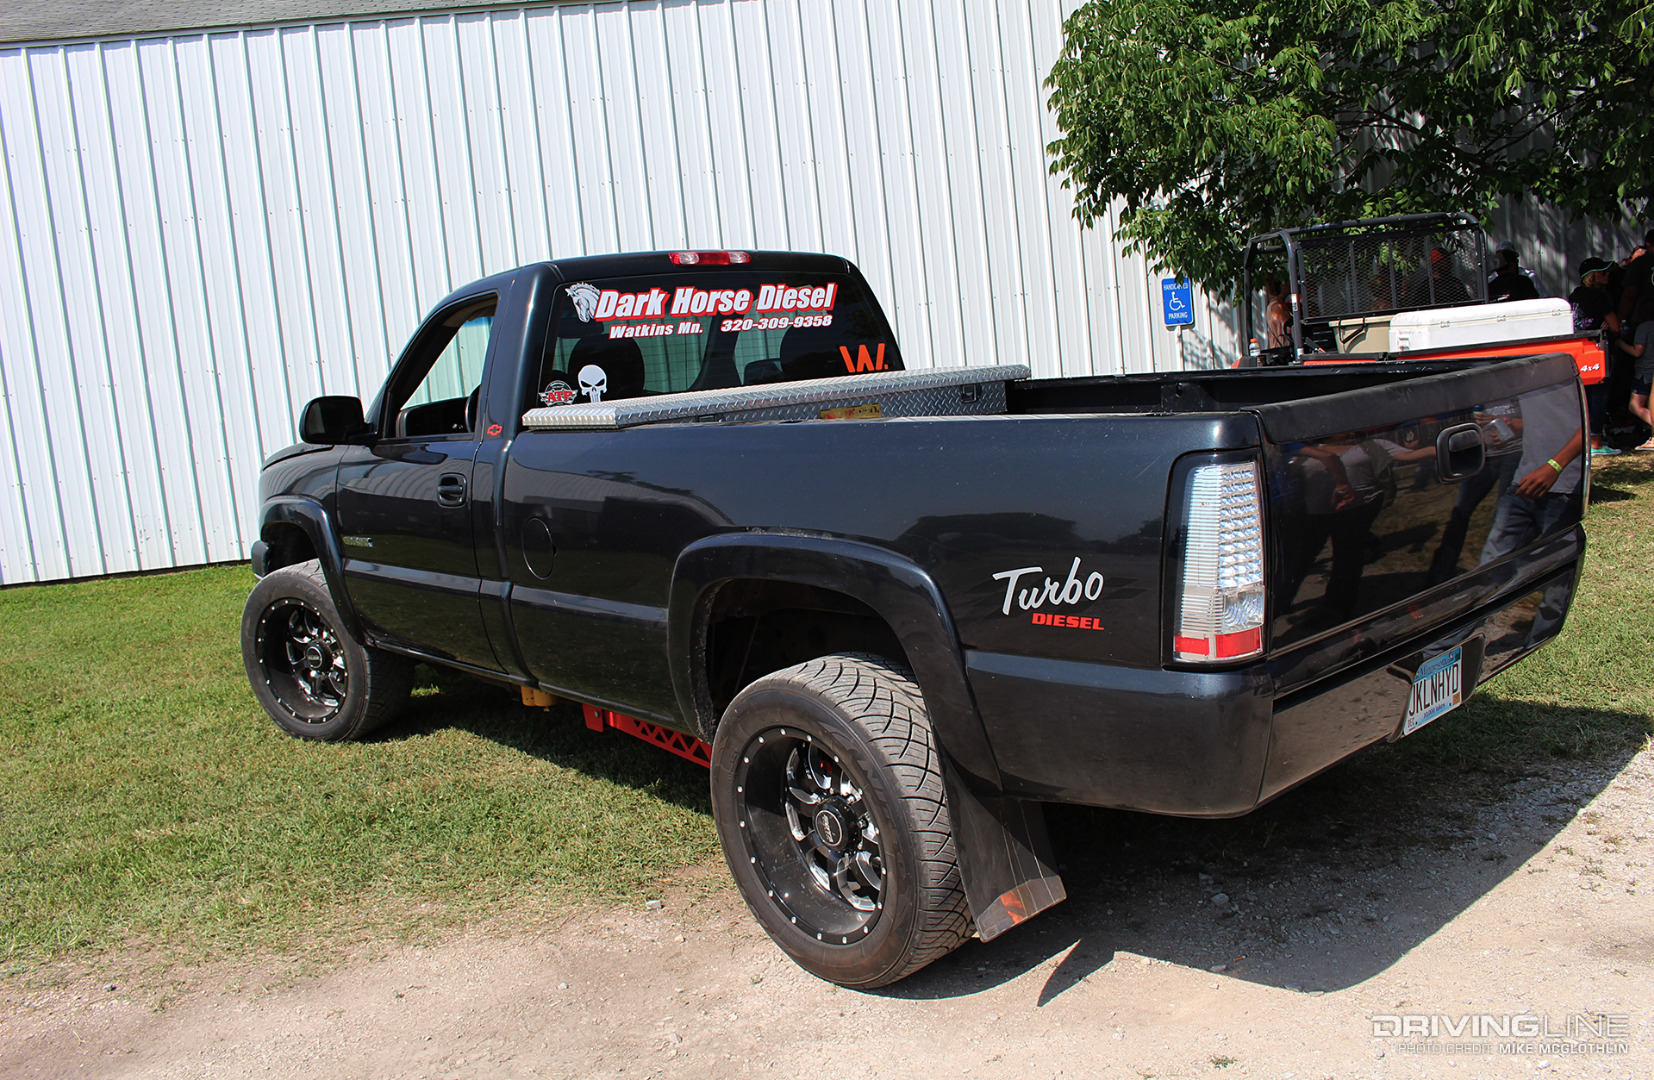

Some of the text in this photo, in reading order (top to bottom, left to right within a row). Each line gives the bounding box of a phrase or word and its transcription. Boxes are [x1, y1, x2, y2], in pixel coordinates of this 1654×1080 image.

[594, 282, 838, 321] Dark Horse Diesel
[609, 314, 833, 339] Watkins Mn. 320-309-9358
[1580, 363, 1600, 372] 4x4
[547, 390, 573, 403] ATP
[992, 556, 1104, 616] Turbo
[1031, 612, 1105, 631] DIESEL
[1408, 663, 1459, 716] JKLNHYD
